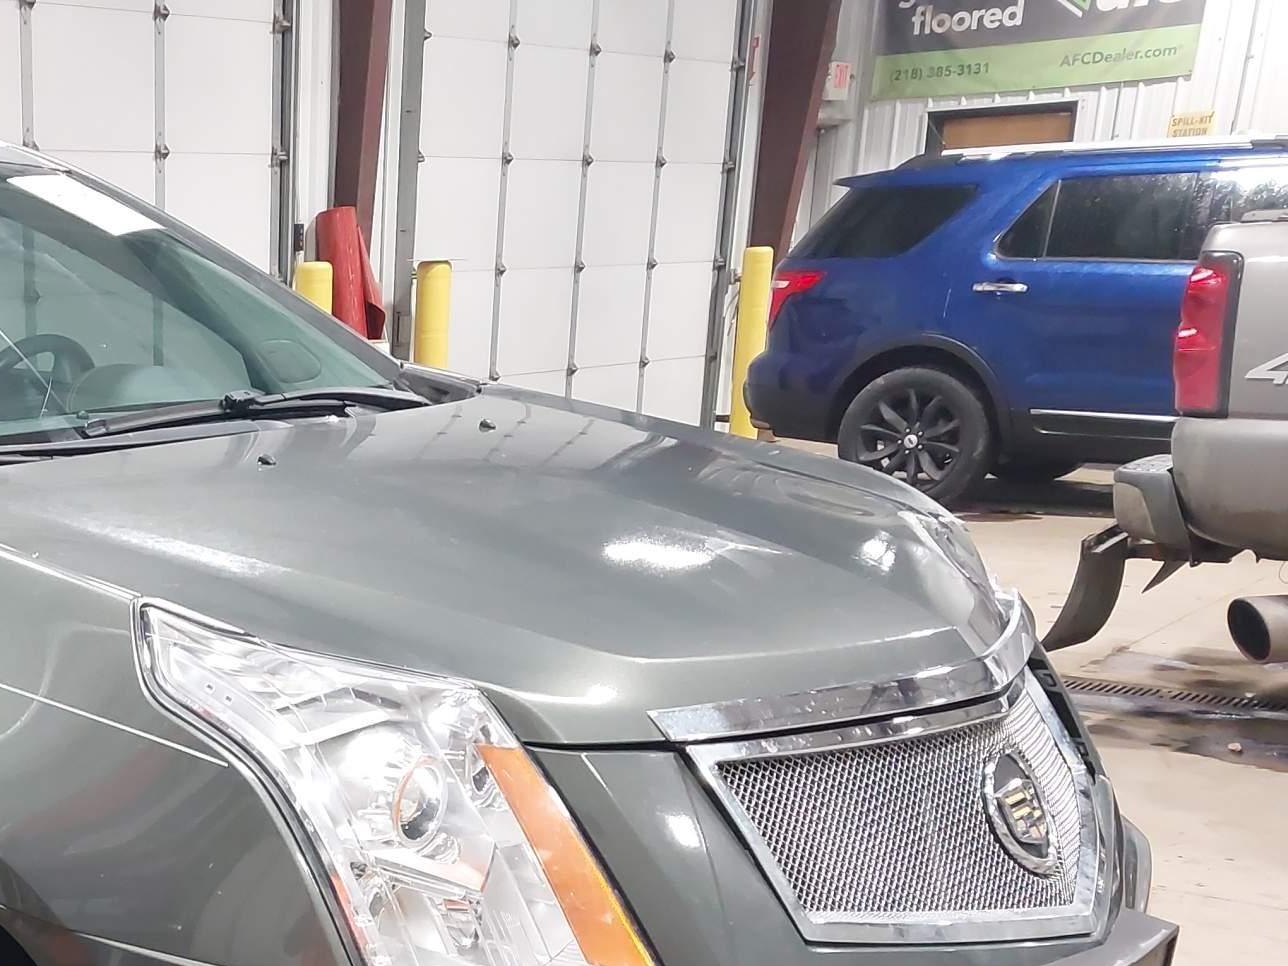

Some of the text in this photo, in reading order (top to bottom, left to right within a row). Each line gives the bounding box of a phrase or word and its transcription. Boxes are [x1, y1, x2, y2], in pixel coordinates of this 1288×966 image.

[912, 0, 1025, 35] floored
[1059, 46, 1177, 67] AFCDealer.com
[890, 66, 922, 84] (218)
[1172, 127, 1208, 138] STATION
